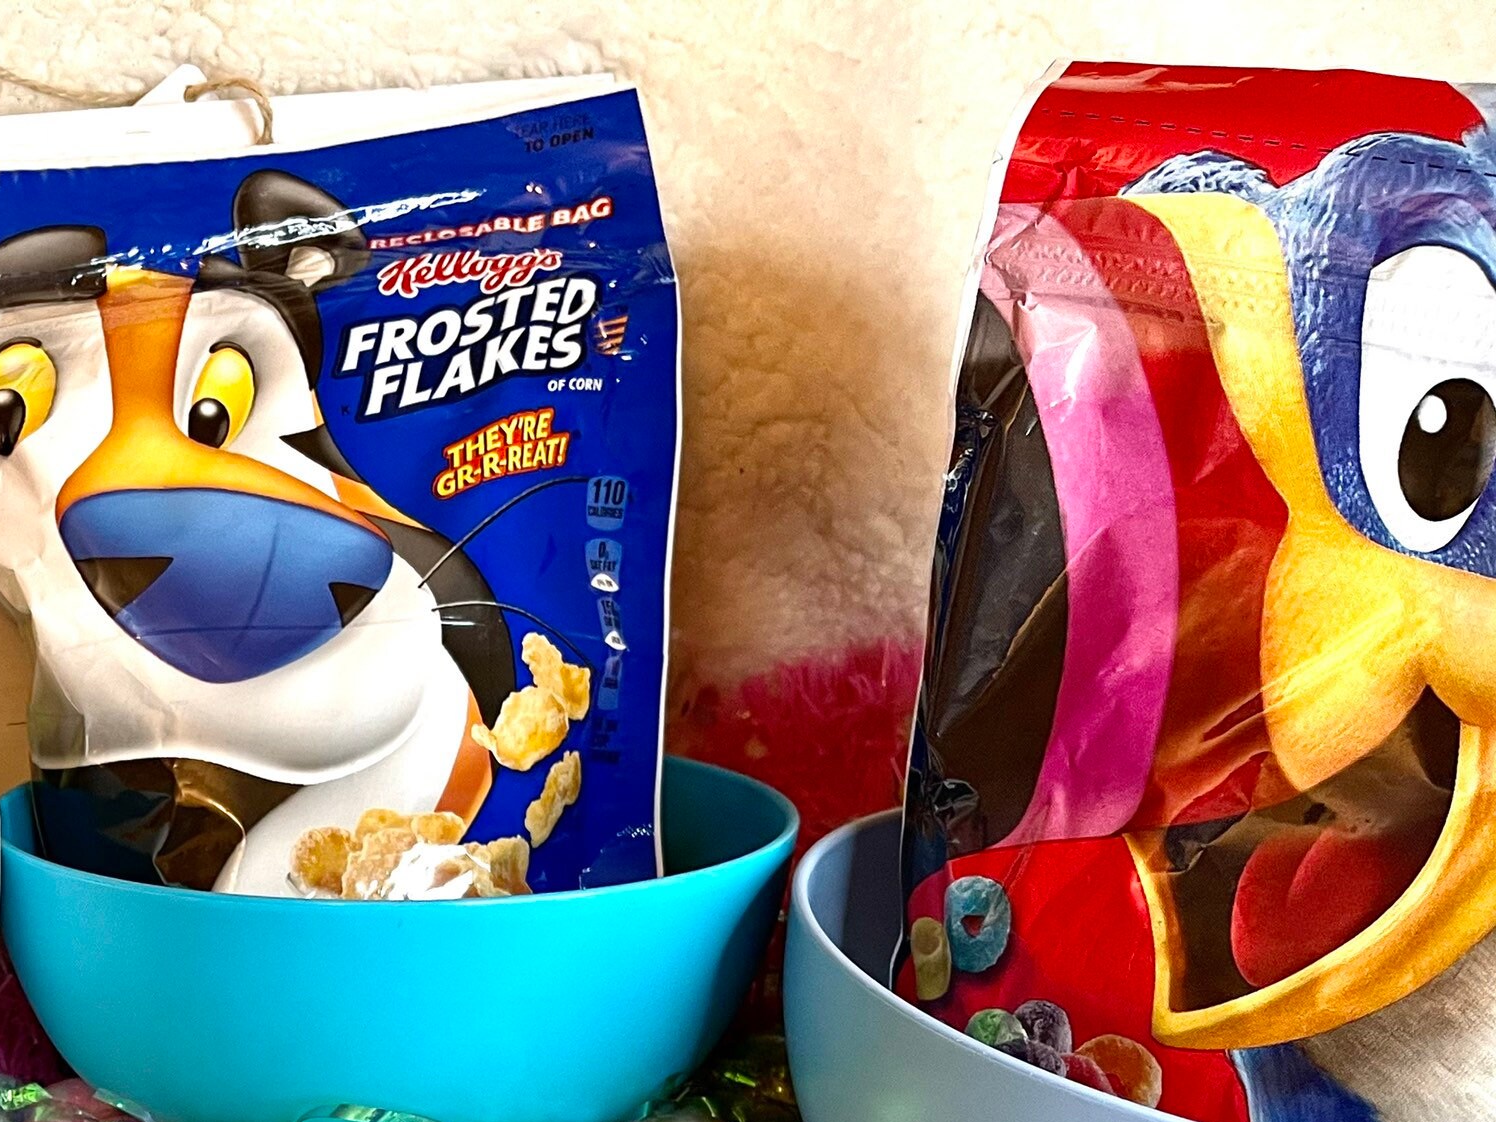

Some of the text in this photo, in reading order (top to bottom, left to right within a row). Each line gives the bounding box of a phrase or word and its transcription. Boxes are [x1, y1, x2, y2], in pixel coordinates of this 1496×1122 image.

[550, 128, 594, 147] OPEN
[370, 196, 612, 249] RECLOSABLE BAG
[378, 249, 562, 297] Kellogg's
[342, 278, 597, 372] FROSTED
[364, 325, 582, 416] FLAKES
[547, 377, 603, 392] OF CORN
[436, 436, 567, 497] GR-R-REAT!
[447, 411, 552, 469] THEY'RE
[593, 478, 626, 505] 110
